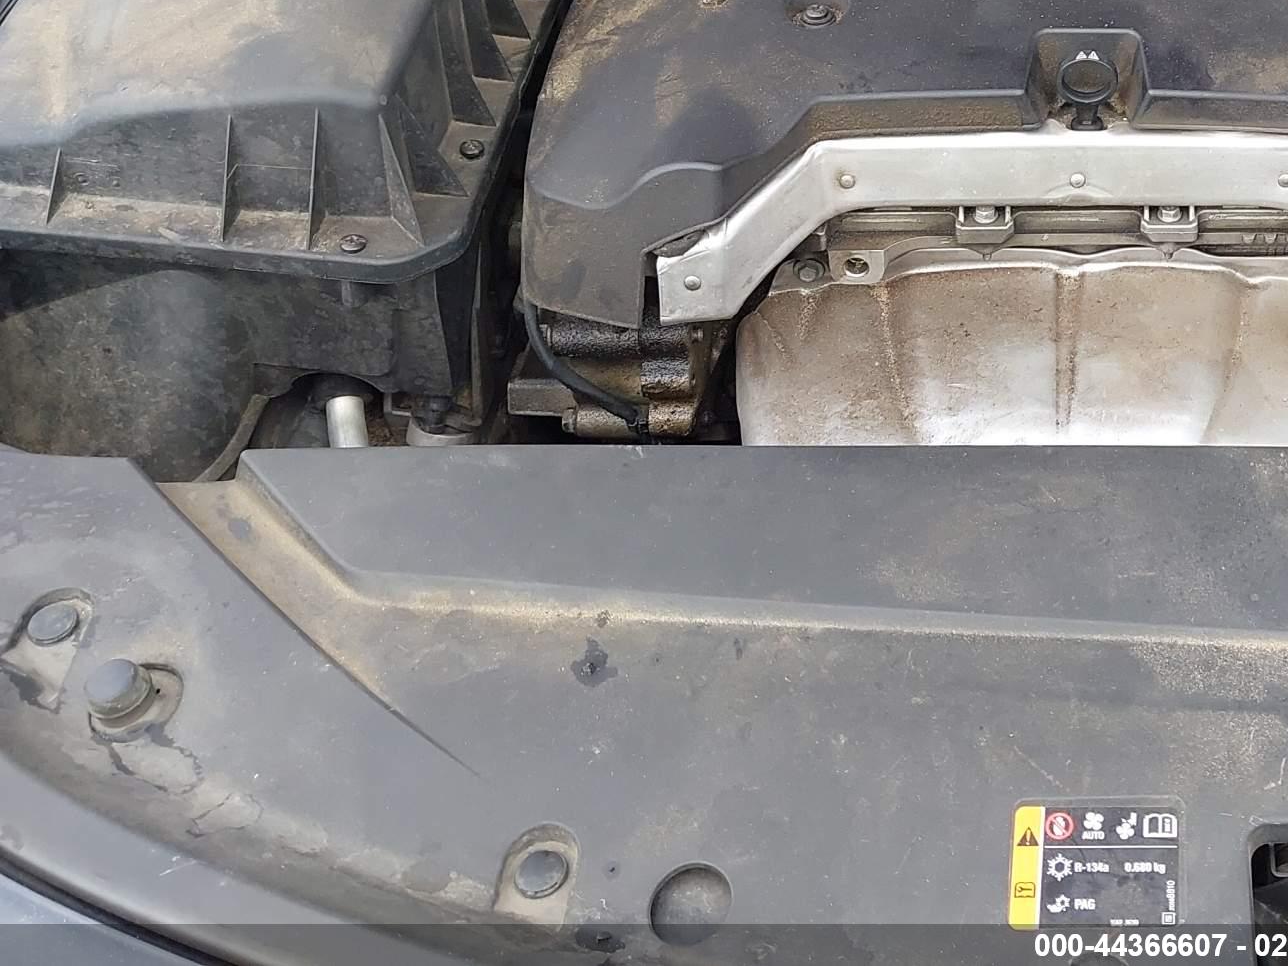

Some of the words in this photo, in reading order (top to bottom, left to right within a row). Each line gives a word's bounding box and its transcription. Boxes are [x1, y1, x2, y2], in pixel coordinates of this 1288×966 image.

[1081, 831, 1105, 840] AUTO
[1073, 862, 1110, 873] R-134a
[1153, 862, 1167, 875] kg
[1073, 898, 1096, 911] PAG
